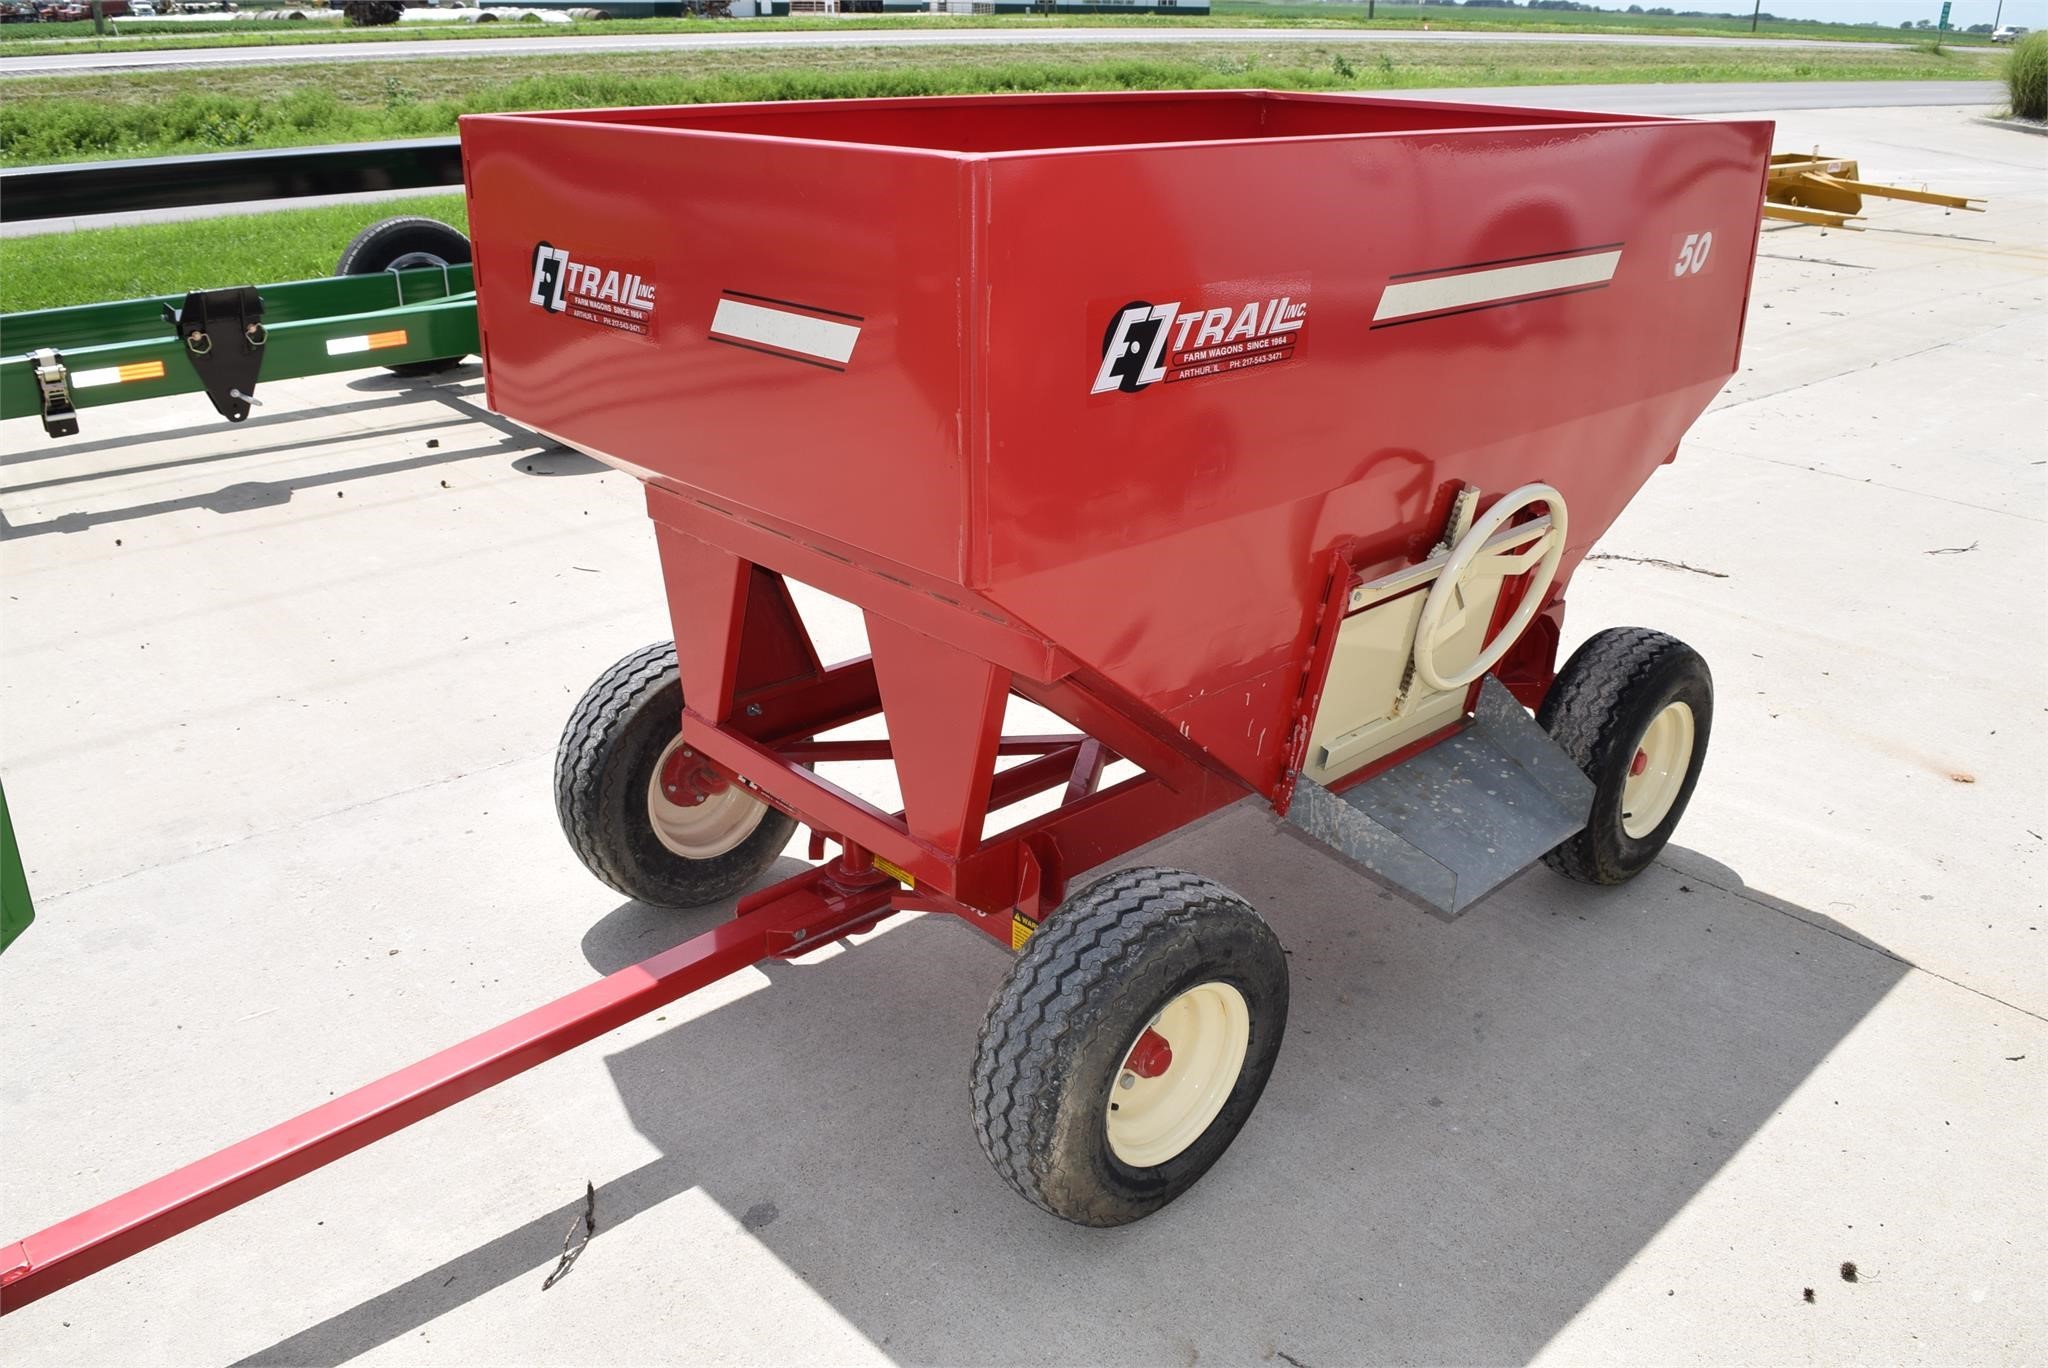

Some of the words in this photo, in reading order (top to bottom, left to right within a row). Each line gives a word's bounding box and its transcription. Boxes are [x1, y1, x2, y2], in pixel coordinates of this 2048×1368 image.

[1674, 231, 1713, 277] 50
[567, 262, 654, 310] TRAIL
[638, 284, 655, 299] INC.
[574, 296, 588, 306] FARM
[589, 299, 612, 312] WAGONS
[613, 306, 629, 316] SINCE
[630, 310, 643, 319] 1964
[1173, 297, 1304, 351] TRAIL
[1283, 301, 1307, 319] INC.
[1184, 351, 1206, 362] FARM
[1209, 344, 1243, 358] WAGONS
[1247, 339, 1269, 351] SINCE
[1271, 336, 1287, 346] 1964
[1213, 364, 1220, 373] IL
[1230, 360, 1240, 369] PH:
[1242, 352, 1282, 367] 217-543-3471
